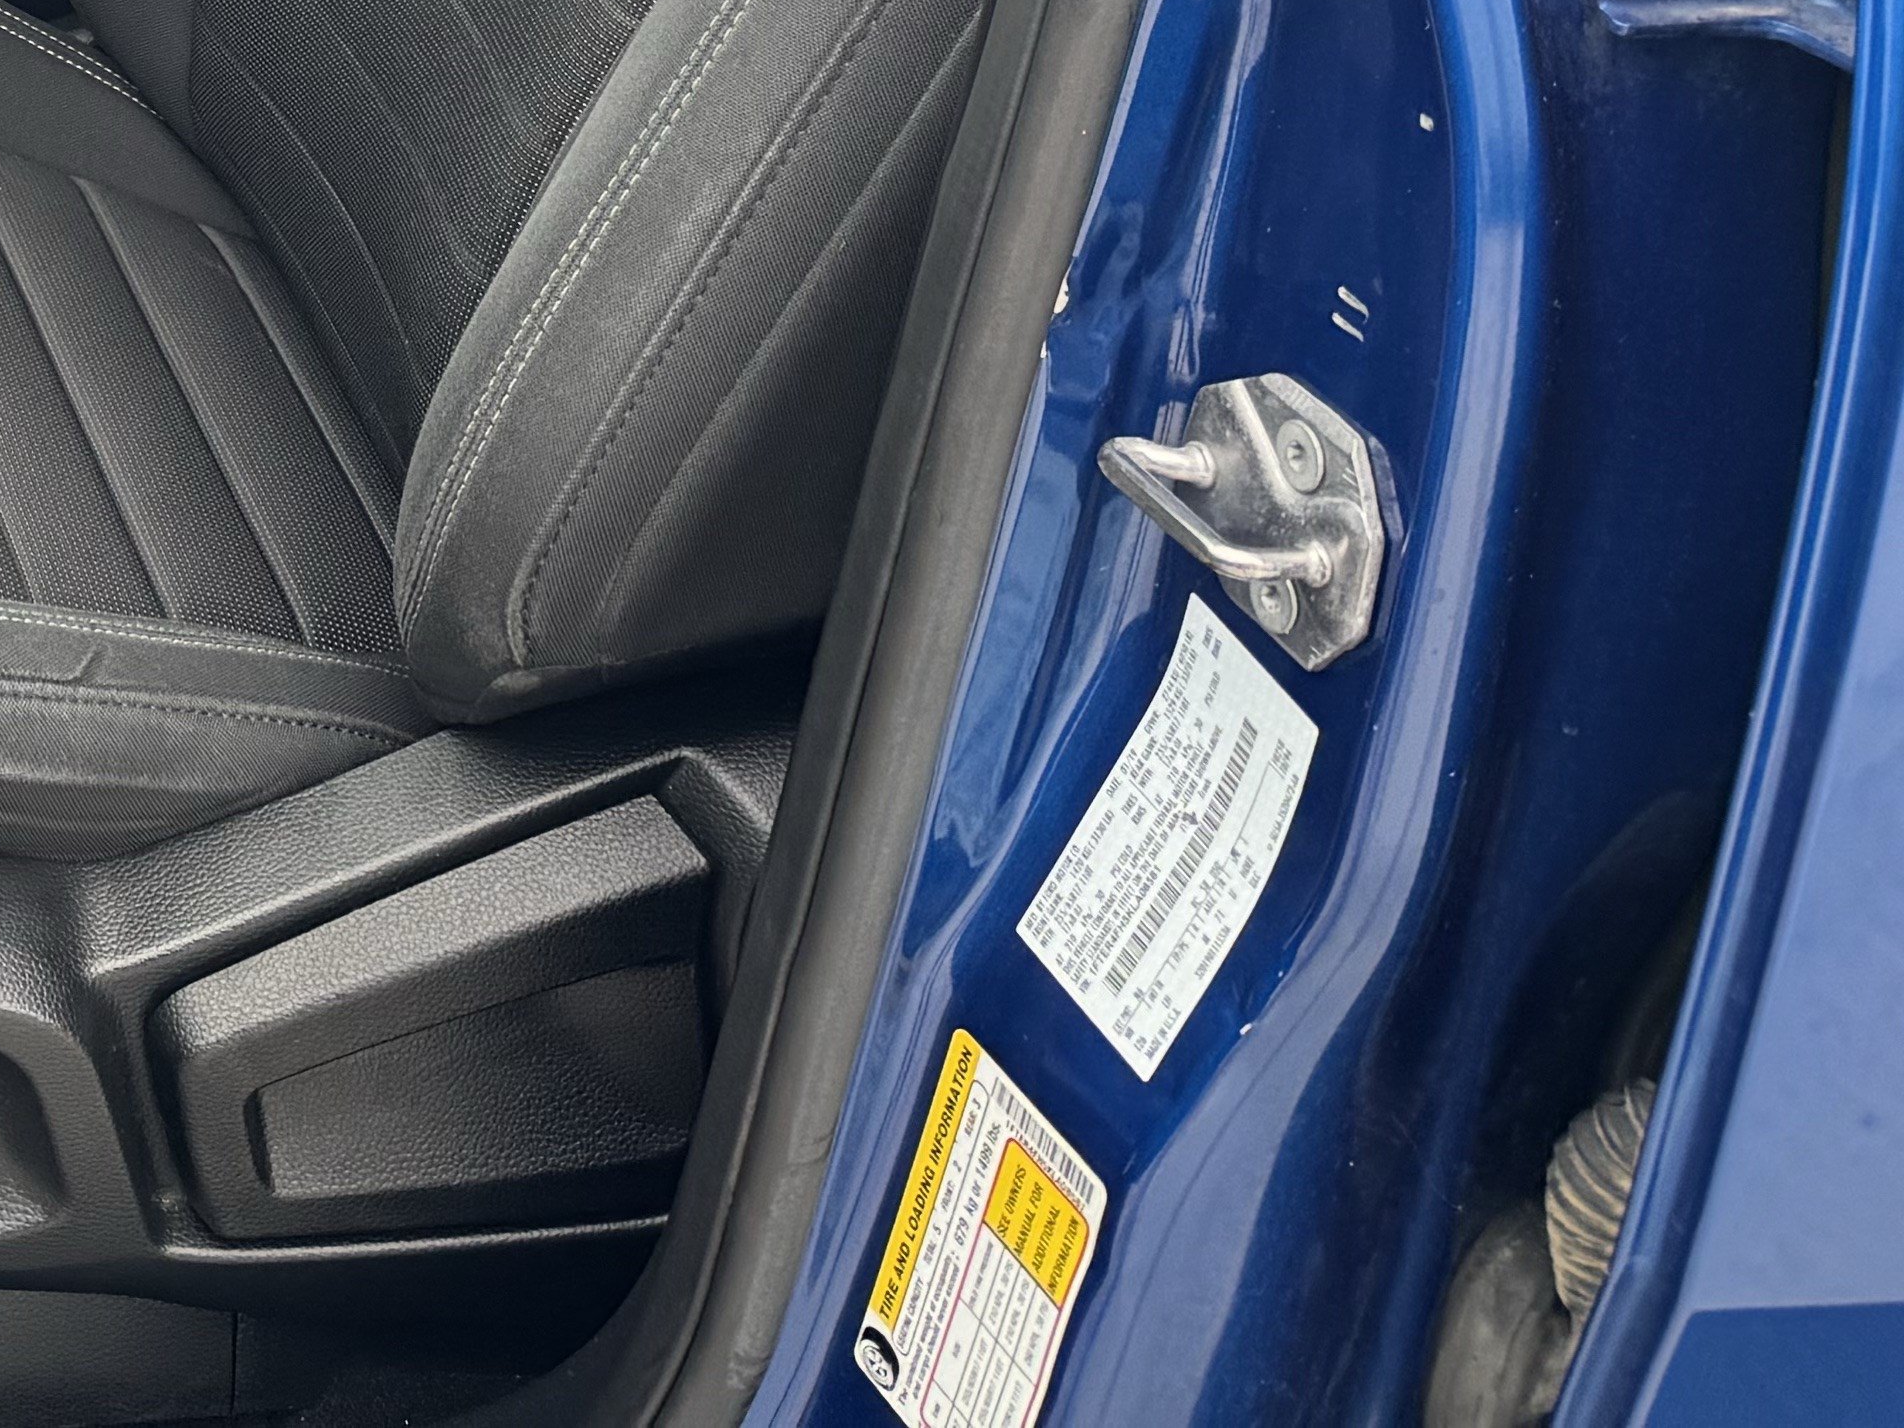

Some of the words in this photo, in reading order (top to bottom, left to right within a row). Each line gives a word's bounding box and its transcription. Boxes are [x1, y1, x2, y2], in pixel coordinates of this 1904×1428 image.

[932, 1223, 941, 1235] 5
[952, 1159, 962, 1173] 2
[971, 1097, 981, 1110] 3
[975, 1142, 992, 1178] 1499
[985, 1122, 1001, 1144] lbs.
[879, 1278, 898, 1318] TIRE
[893, 1241, 910, 1280] AND
[904, 1166, 934, 1240] LOADING
[929, 1046, 971, 1164] INFORMATION
[963, 1196, 978, 1216] kg
[971, 1179, 981, 1197] or
[996, 1213, 1010, 1238] SEE
[1004, 1164, 1026, 1214] OWNERS
[953, 1216, 969, 1246] 679
[1013, 1209, 1035, 1256] MANUAL
[1028, 1181, 1043, 1209] FOR
[1031, 1206, 1060, 1272] ADDITIONAL
[1047, 1216, 1078, 1294] INFORMATION
